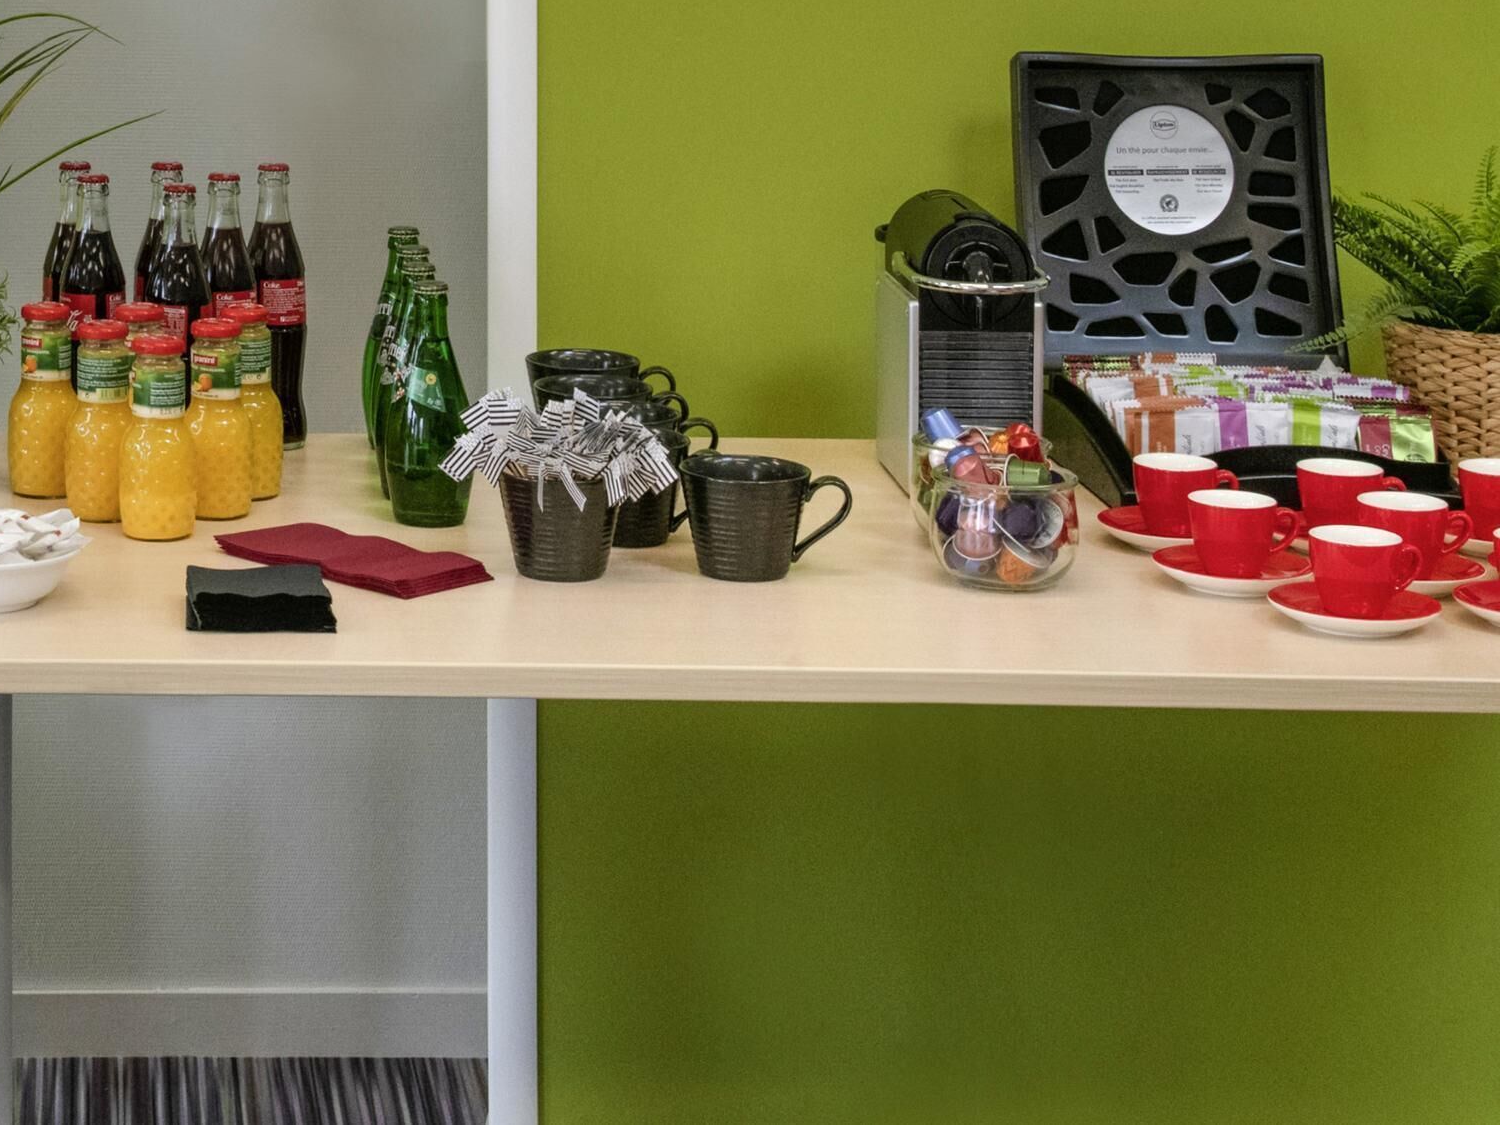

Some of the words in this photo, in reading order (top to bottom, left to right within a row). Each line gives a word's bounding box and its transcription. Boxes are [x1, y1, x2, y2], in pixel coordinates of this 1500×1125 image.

[1116, 146, 1127, 154] Un
[1142, 147, 1159, 155] pour
[1160, 146, 1187, 155] chaque
[263, 281, 281, 289] Coke
[216, 293, 234, 301] Coke
